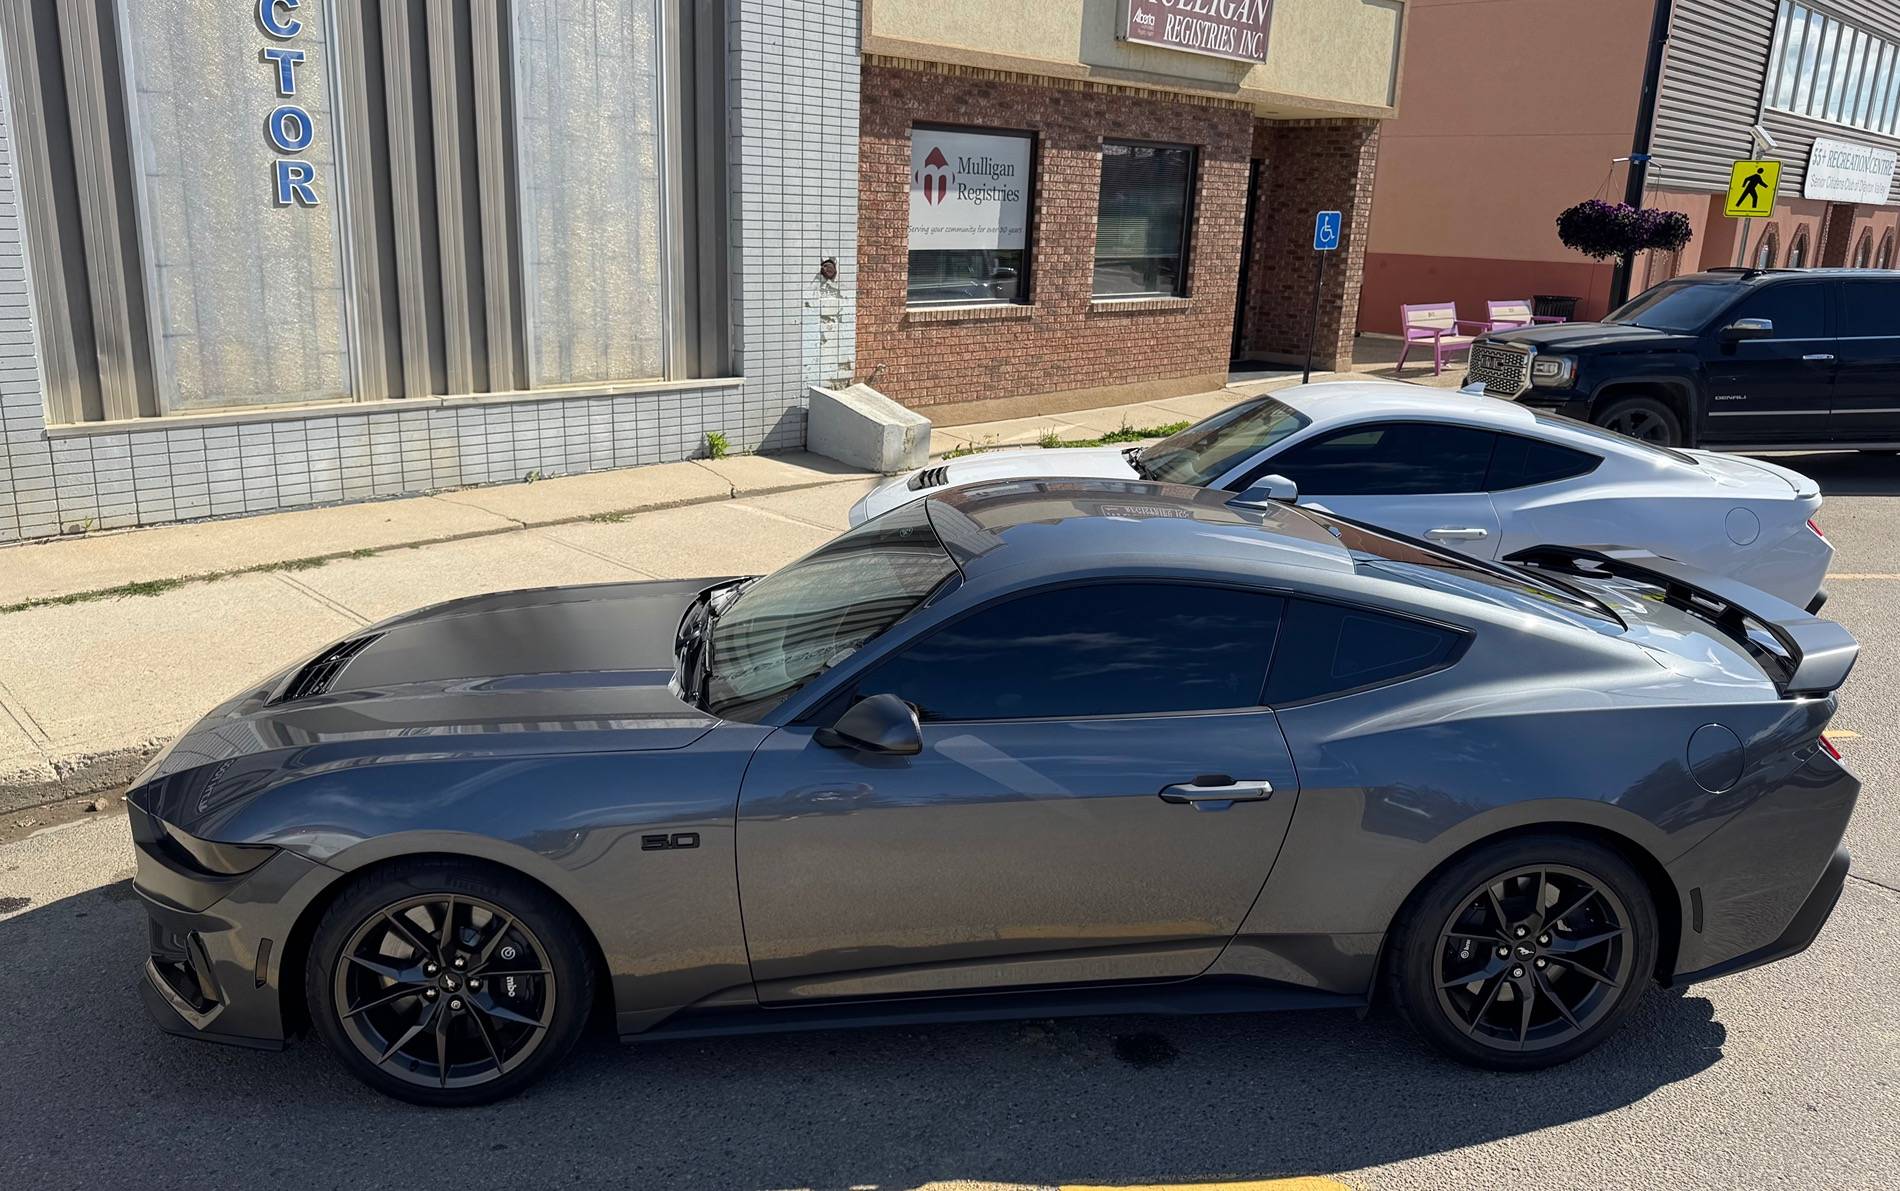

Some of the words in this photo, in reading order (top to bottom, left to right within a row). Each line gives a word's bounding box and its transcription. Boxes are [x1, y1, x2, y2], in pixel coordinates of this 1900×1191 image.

[1148, 0, 1271, 27] LIGAN
[1163, 13, 1237, 53] REGISTRIES
[1238, 29, 1264, 59] INC.
[957, 156, 1015, 181] Mulligan
[1826, 150, 1869, 173] RECREATION
[1868, 156, 1894, 176] CENTRE
[957, 182, 1020, 206] Registries
[907, 224, 929, 235] Serving
[930, 225, 945, 235] your
[945, 225, 976, 235] community
[641, 833, 700, 851] 5.0
